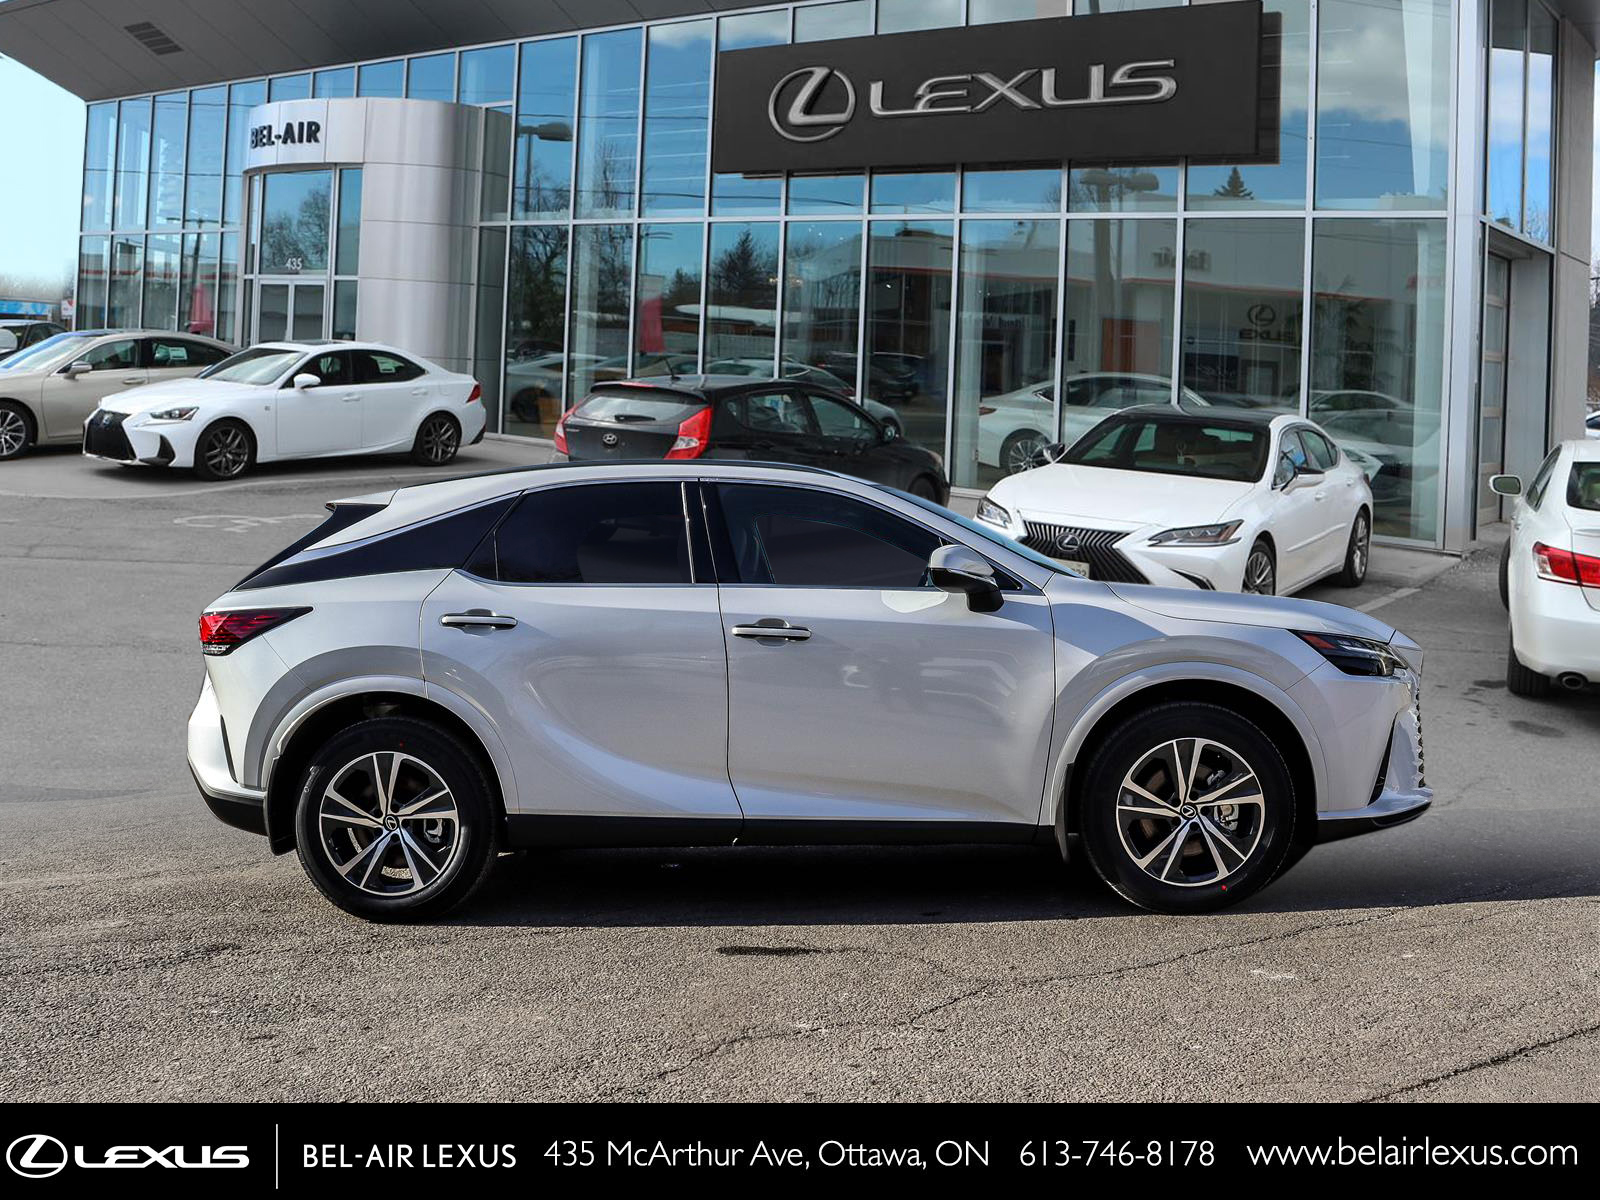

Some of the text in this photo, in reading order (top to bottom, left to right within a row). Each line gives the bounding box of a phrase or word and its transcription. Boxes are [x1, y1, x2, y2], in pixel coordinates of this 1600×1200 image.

[869, 58, 1178, 118] LEXUS
[250, 121, 321, 149] BEL-AIR
[285, 257, 303, 270] 435
